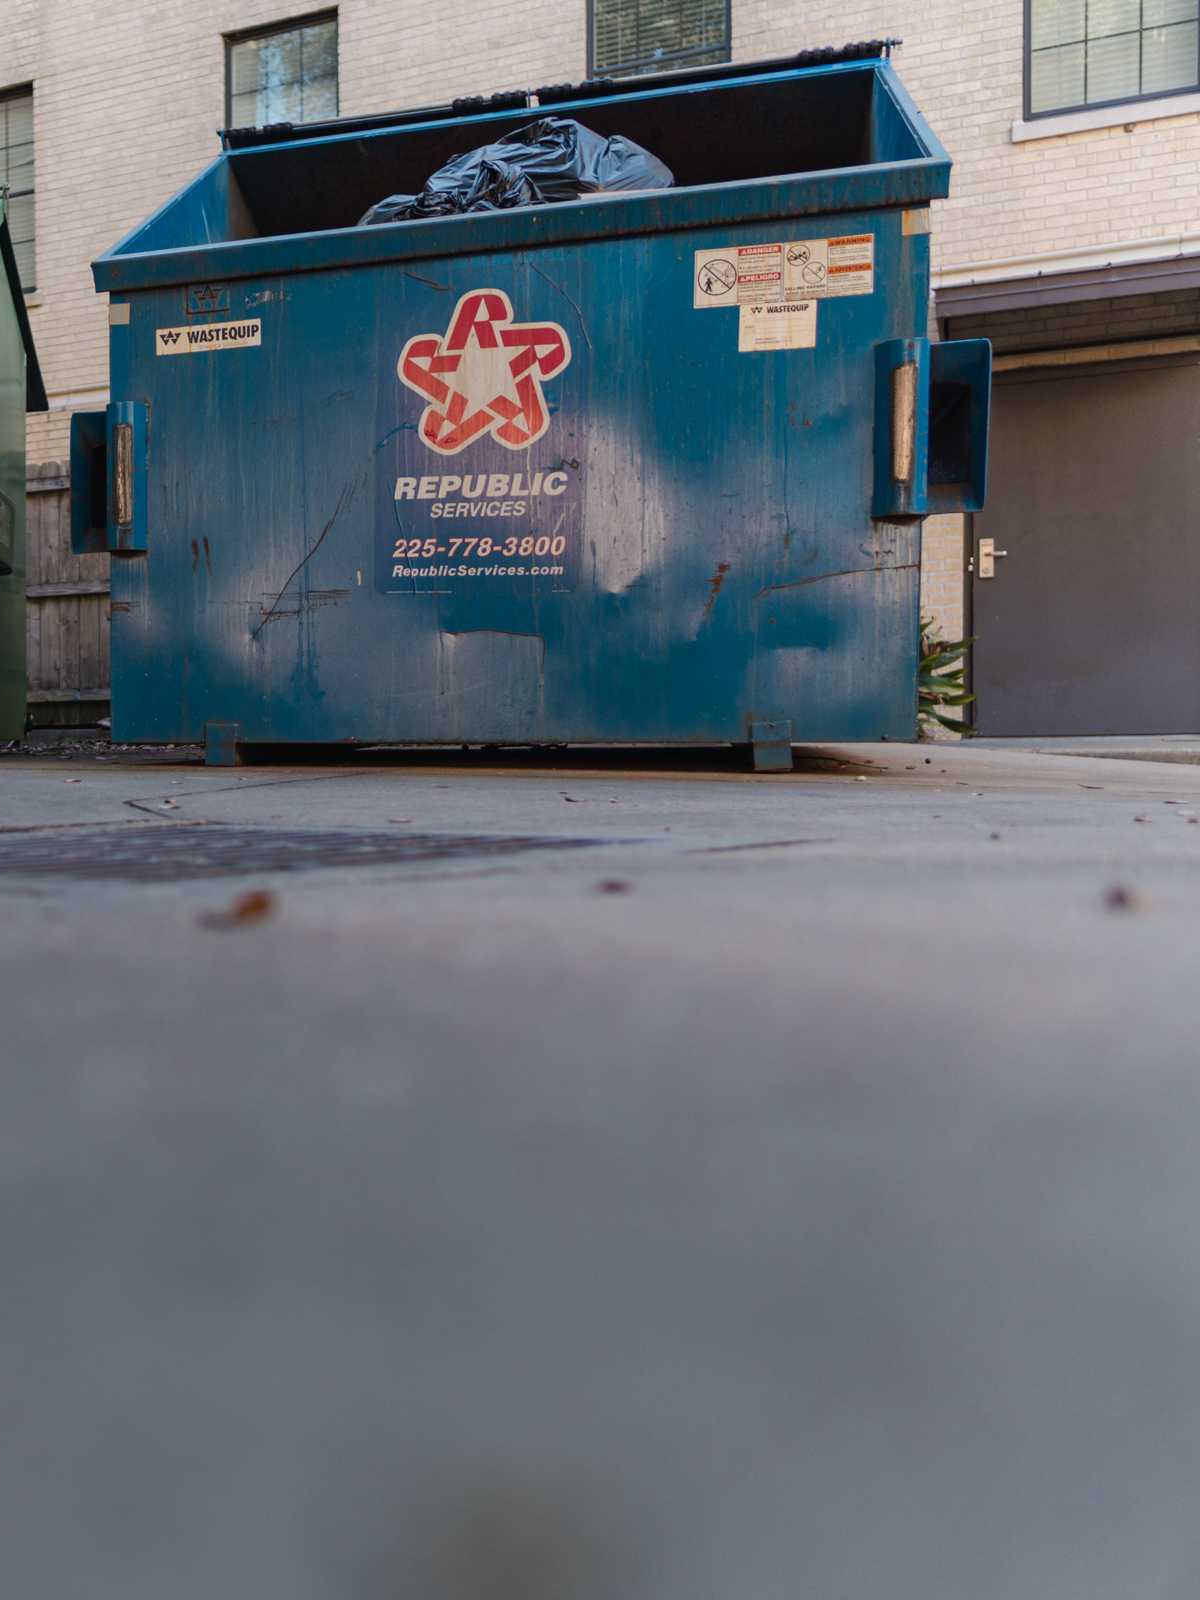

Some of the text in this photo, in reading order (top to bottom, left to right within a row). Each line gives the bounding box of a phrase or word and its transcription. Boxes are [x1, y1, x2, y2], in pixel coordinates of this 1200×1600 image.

[766, 304, 809, 314] WASTEQUIP
[187, 324, 260, 344] WASTEQUIP
[393, 472, 568, 500] REPUBLIC
[430, 501, 527, 518] SERVICES
[392, 536, 567, 558] 225-778-3800
[392, 564, 564, 577] RepublicServices.com
